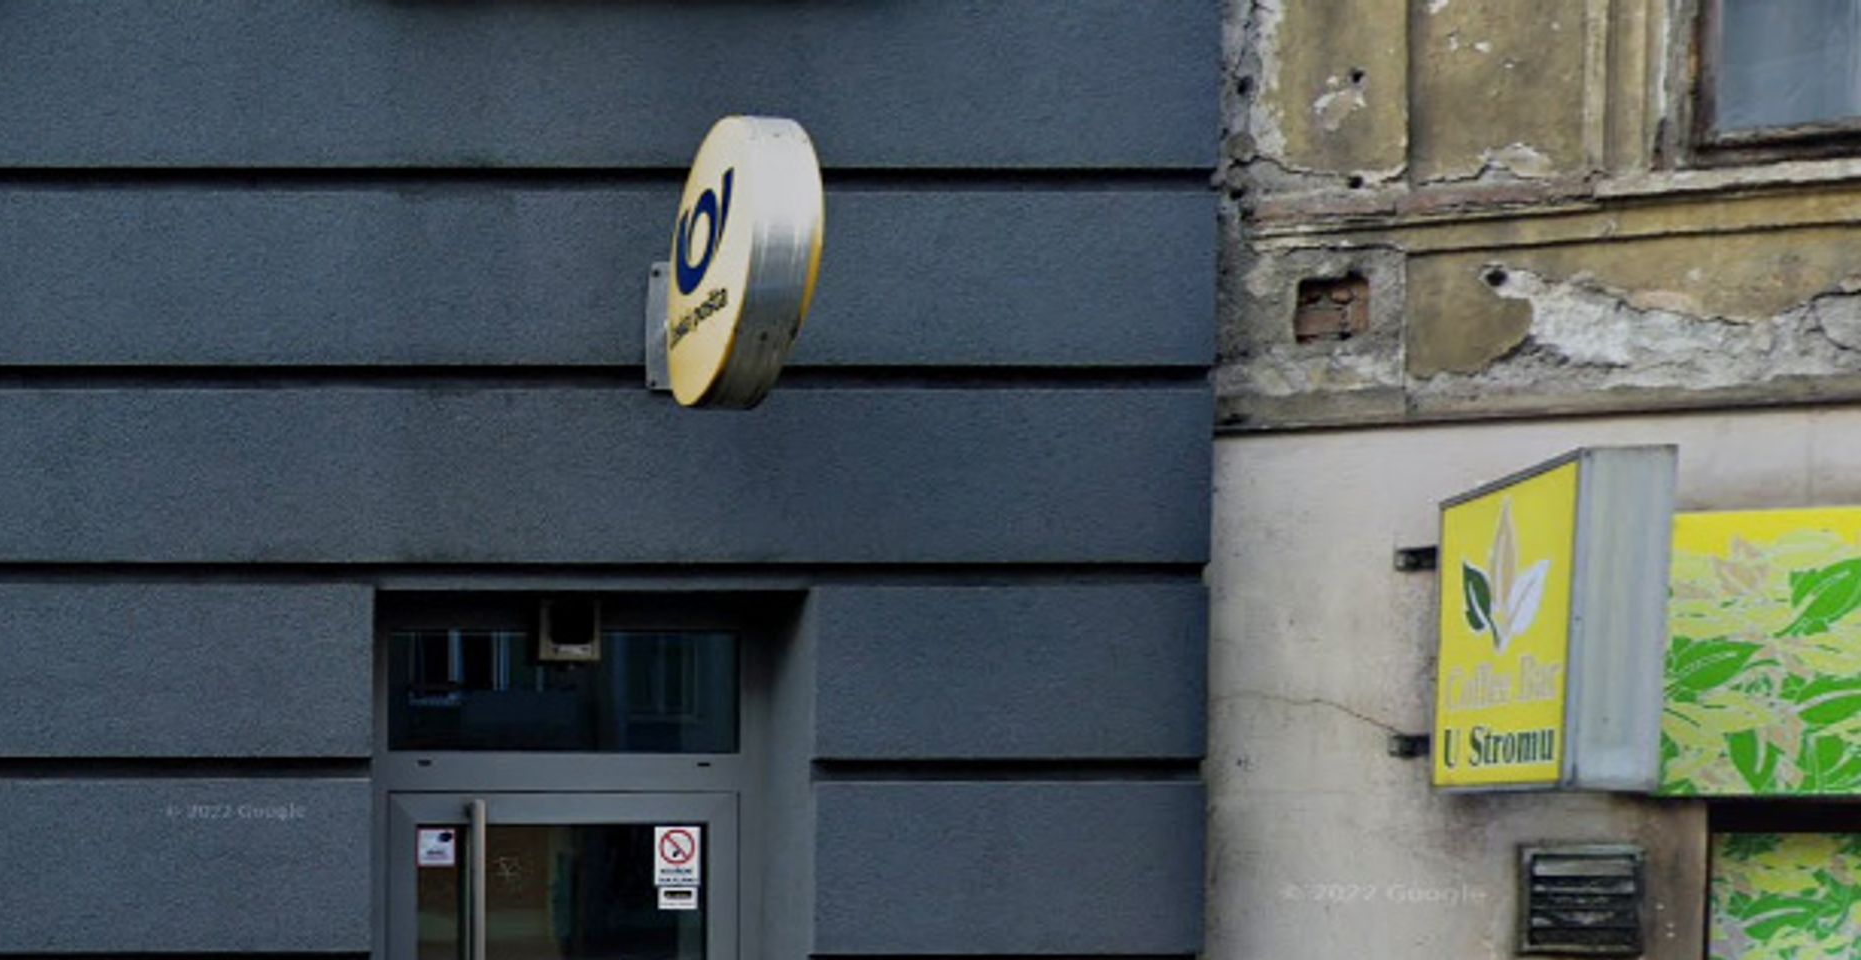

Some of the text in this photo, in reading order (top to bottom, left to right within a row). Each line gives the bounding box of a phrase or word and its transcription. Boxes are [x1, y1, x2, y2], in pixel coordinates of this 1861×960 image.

[1445, 653, 1561, 712] Coffee Bar
[1443, 724, 1555, 769] U Stromu
